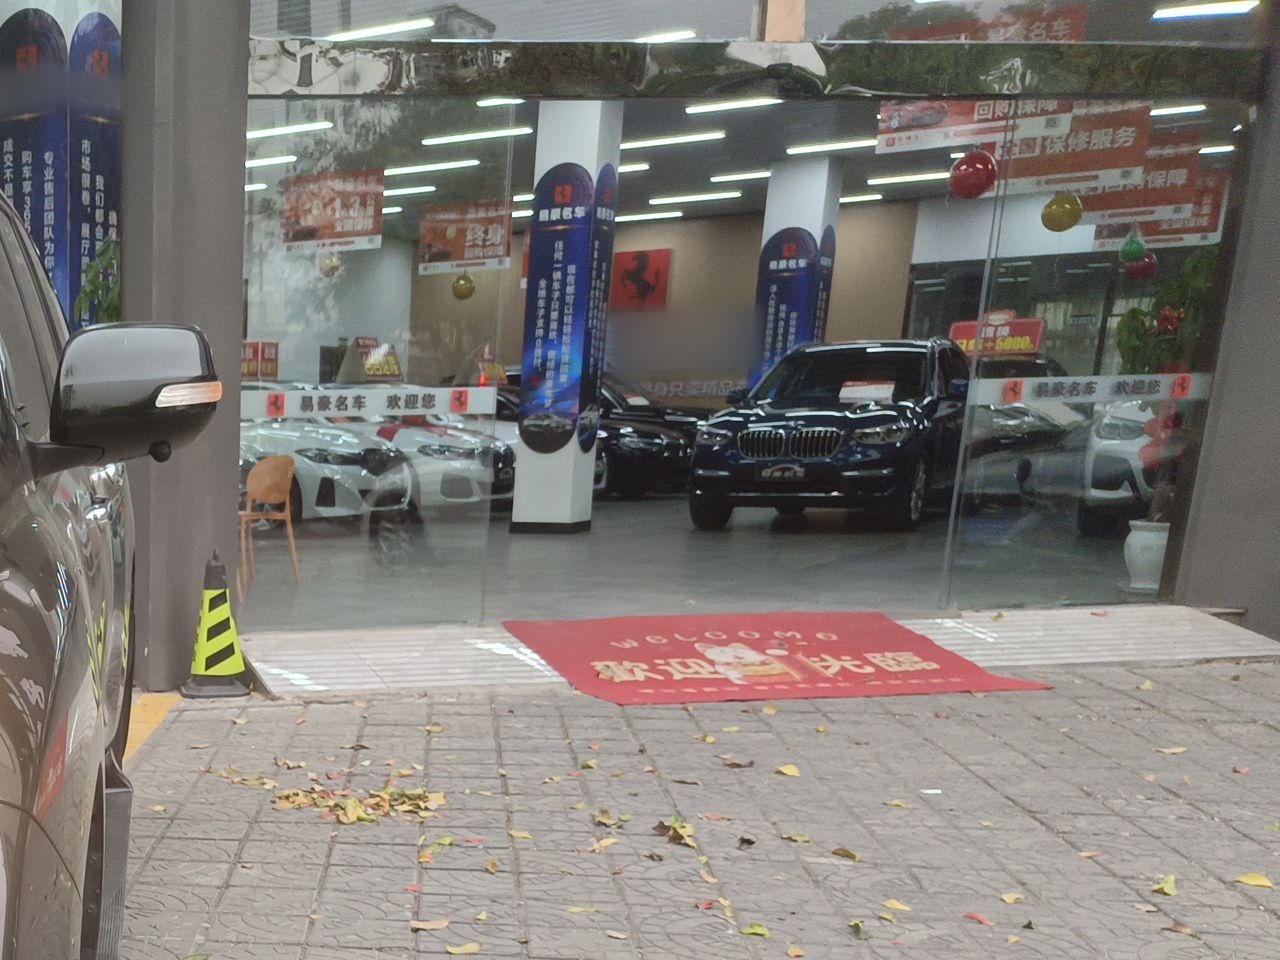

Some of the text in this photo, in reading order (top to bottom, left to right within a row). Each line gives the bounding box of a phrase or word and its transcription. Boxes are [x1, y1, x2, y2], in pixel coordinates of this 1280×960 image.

[43, 151, 55, 279] 专业售后团队为你
[300, 393, 436, 412] 易豪名车 欢迎您
